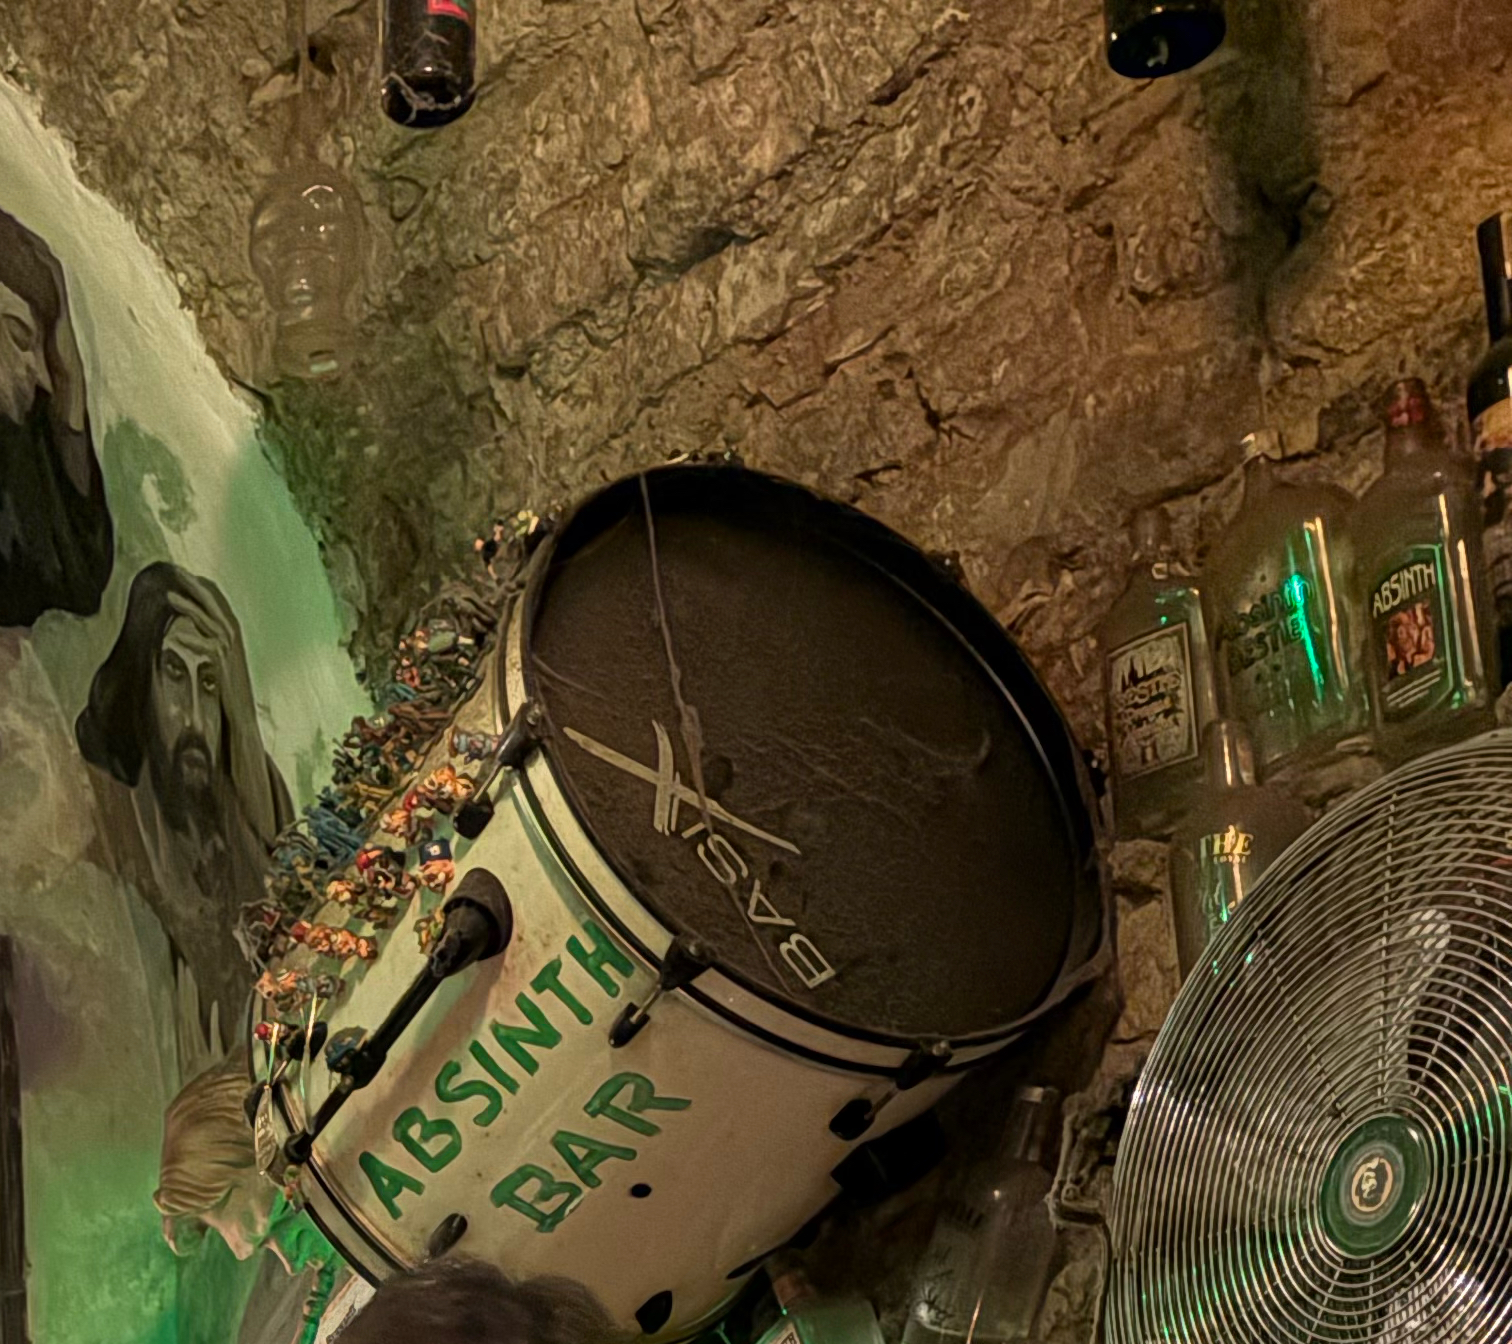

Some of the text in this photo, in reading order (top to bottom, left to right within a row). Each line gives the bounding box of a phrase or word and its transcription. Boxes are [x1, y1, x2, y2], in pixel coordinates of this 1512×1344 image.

[1372, 562, 1437, 619] ABSINTH
[357, 919, 635, 1220] ABSINTH
[490, 1070, 691, 1232] BAR
